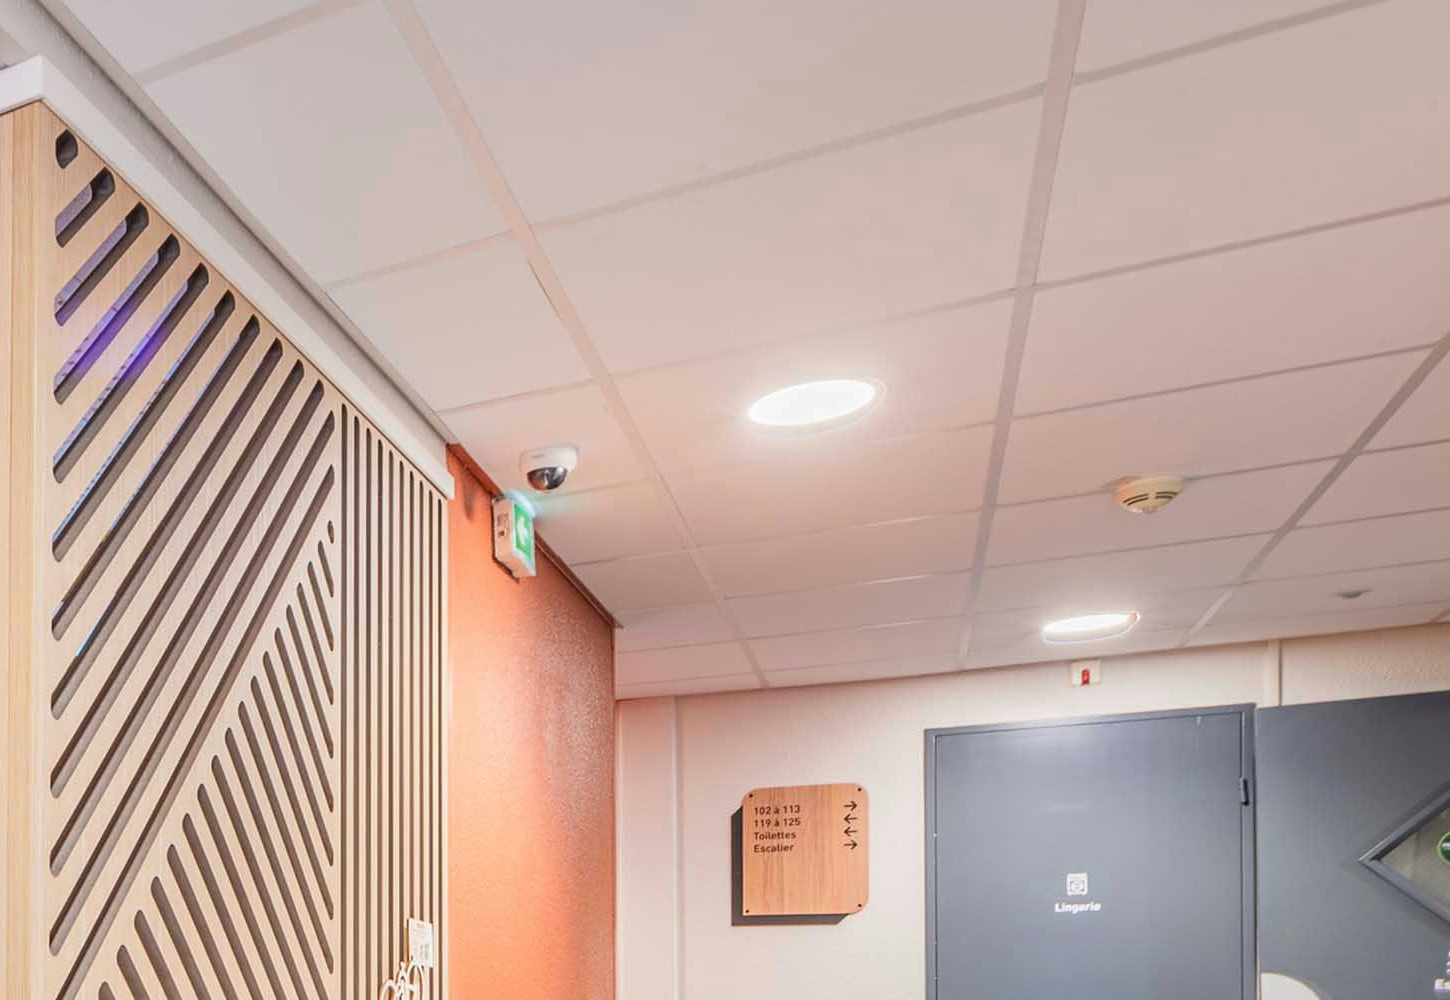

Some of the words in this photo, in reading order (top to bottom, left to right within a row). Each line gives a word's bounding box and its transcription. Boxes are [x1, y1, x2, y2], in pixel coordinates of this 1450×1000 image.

[754, 806, 772, 815] 102
[783, 804, 801, 814] 113
[754, 819, 772, 828] 119
[783, 817, 801, 827] 125
[754, 832, 796, 840] Toilettes
[753, 844, 794, 853] Escalier
[1054, 901, 1102, 914] Lingerie
